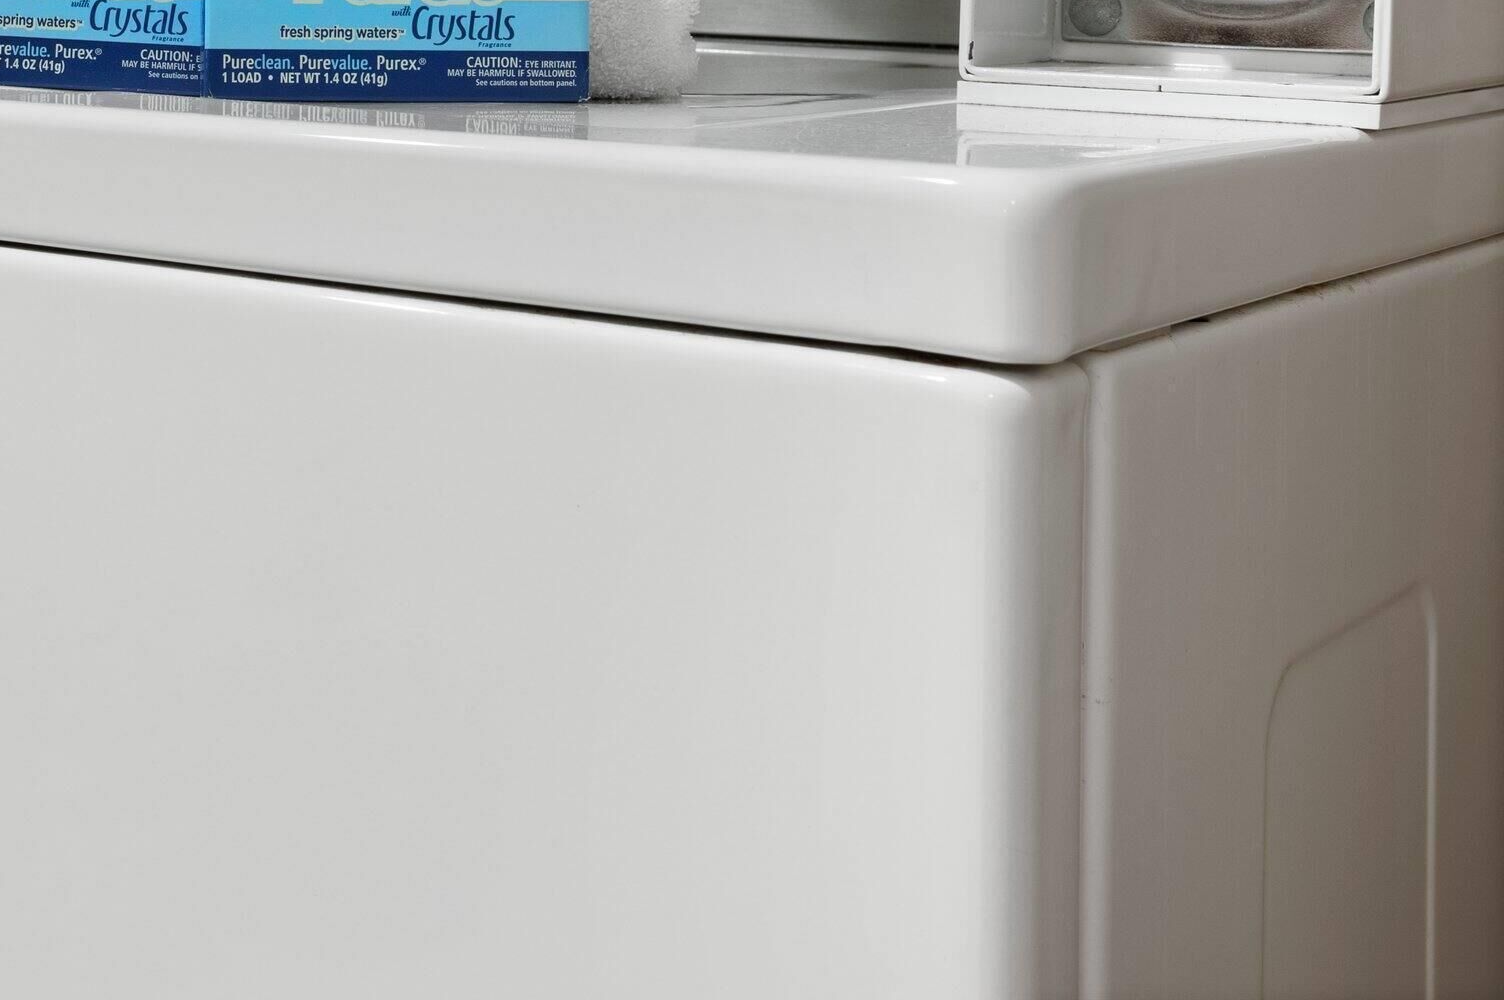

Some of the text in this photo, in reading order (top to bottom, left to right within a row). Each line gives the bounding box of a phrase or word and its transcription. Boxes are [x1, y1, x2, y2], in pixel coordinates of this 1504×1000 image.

[391, 5, 516, 46] with Crystals
[151, 35, 185, 43] Fragrance
[280, 25, 311, 40] fresh
[314, 25, 353, 41] spring
[477, 41, 513, 49] Fragrance
[140, 49, 193, 63] CAUTION:
[222, 53, 295, 70] Pureclean.
[299, 54, 373, 70] Purevalue.
[466, 56, 577, 69] CAUTION: EYE IRRITANT.
[4, 58, 20, 70] 1.4
[22, 59, 37, 71] OZ
[39, 59, 66, 75] (41g)
[121, 60, 138, 68] MAY
[140, 61, 150, 69] BE
[151, 61, 187, 71] HARMFUL
[188, 63, 196, 72] IF
[148, 70, 161, 78] See
[161, 71, 189, 80] cautions
[222, 72, 388, 87] 1 LOAD NET WT 1.4 OZ (41g)
[447, 69, 577, 78] MAY BE HARMFUL IF SWALLOWED.
[475, 79, 488, 87] See
[489, 79, 518, 87] cautions
[529, 79, 555, 87] bottom
[556, 79, 577, 88] panel.
